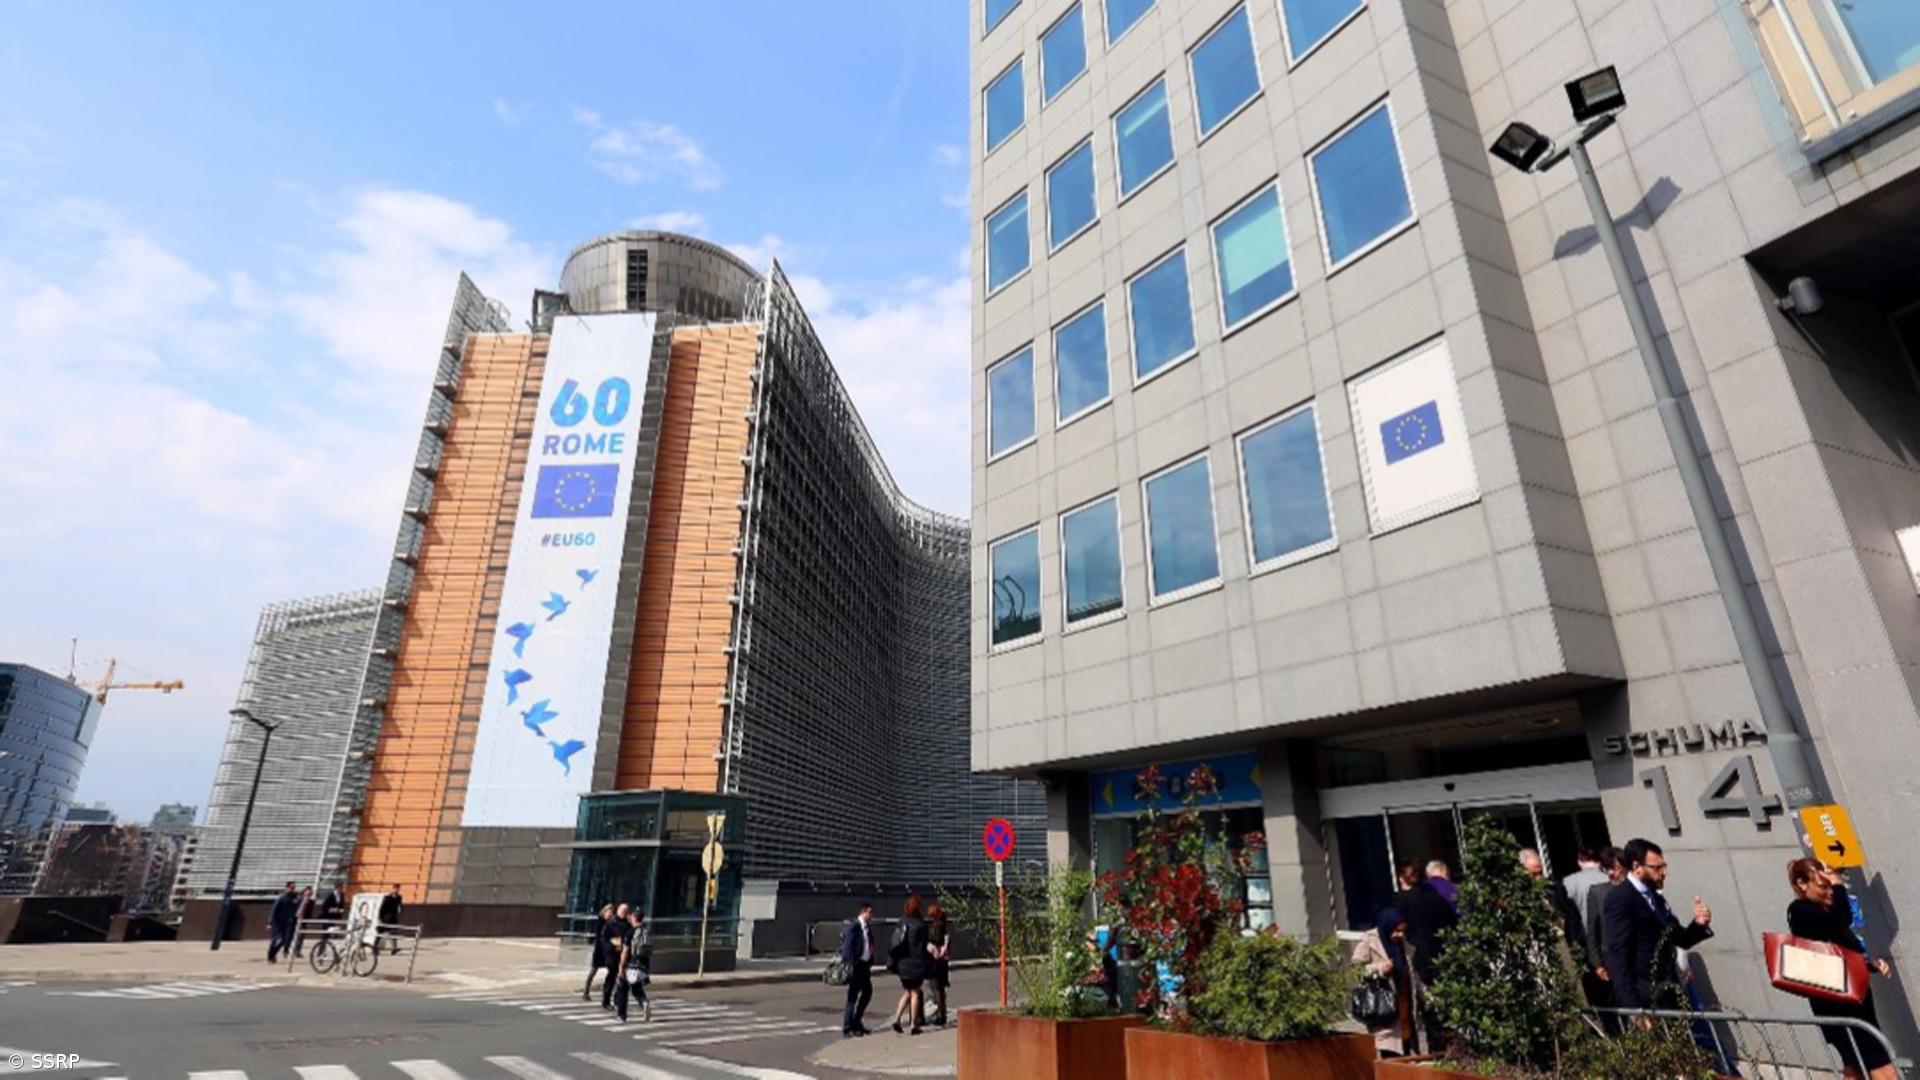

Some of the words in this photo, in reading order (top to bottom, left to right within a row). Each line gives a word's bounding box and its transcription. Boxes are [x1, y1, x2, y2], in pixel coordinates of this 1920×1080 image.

[550, 376, 631, 427] 60
[542, 433, 625, 455] ROME
[541, 532, 596, 547] #EU60
[1604, 719, 1768, 758] SCHUMA
[1639, 755, 1784, 837] 14
